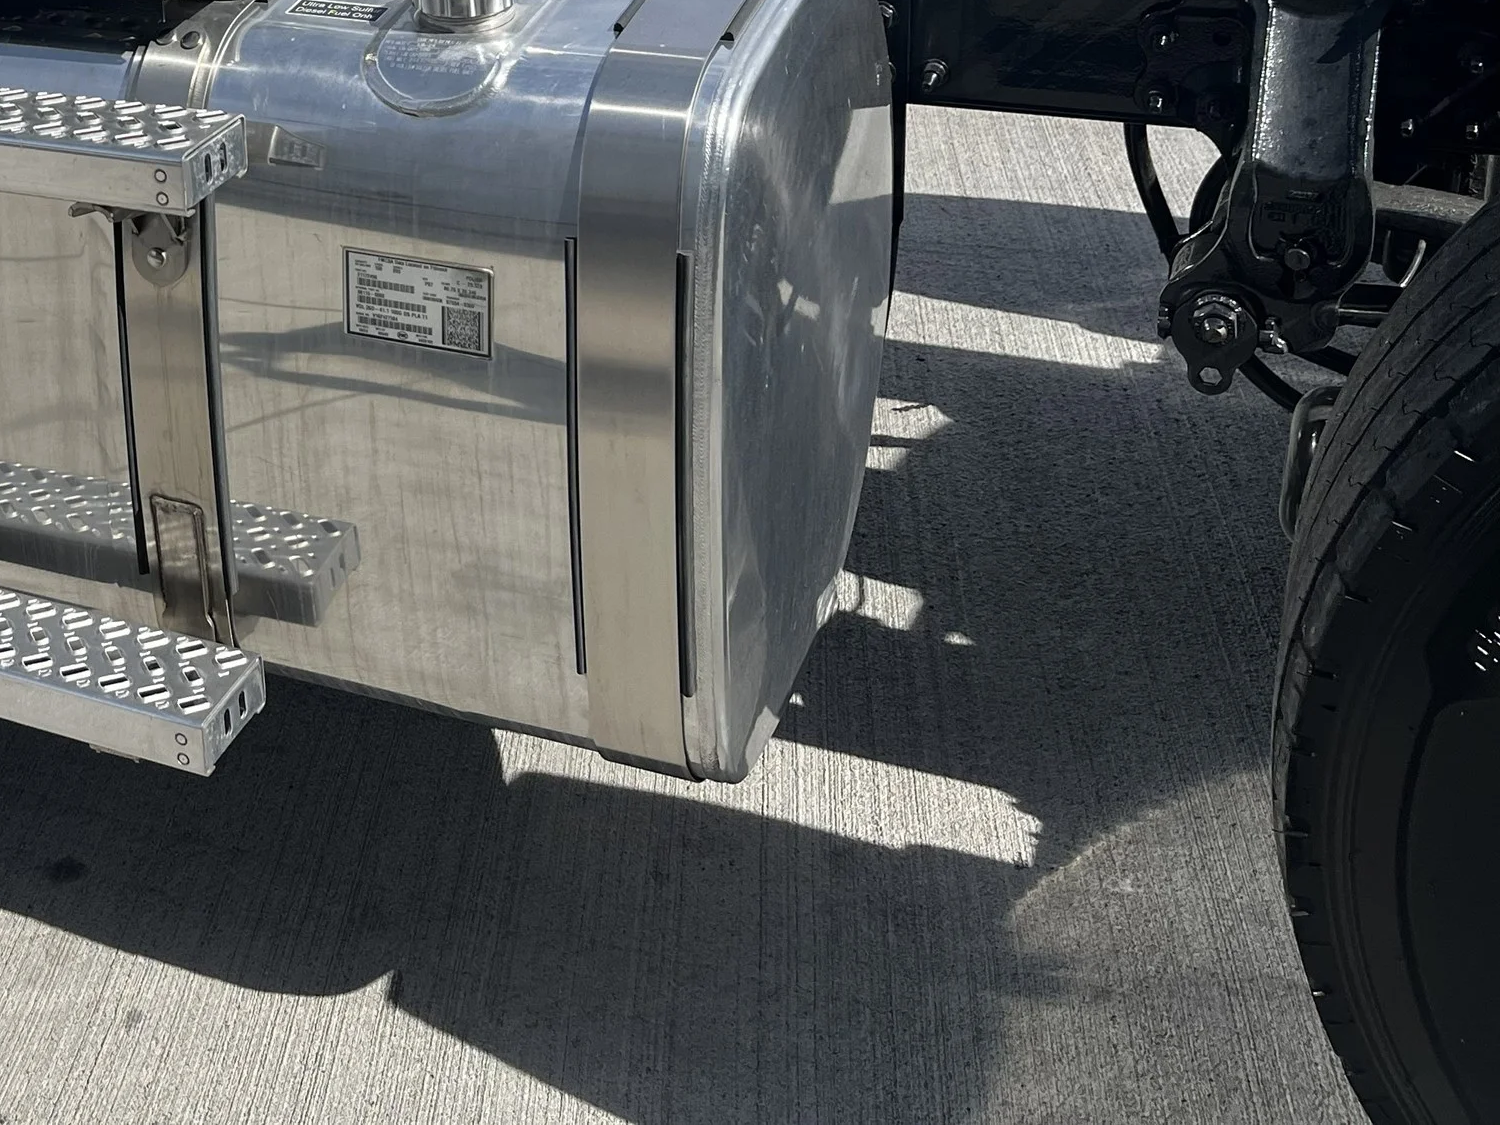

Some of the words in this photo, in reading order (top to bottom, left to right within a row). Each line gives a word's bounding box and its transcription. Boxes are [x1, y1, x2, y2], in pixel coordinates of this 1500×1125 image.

[301, 1, 326, 9] Ultra
[327, 3, 350, 11] Low
[295, 6, 327, 15] Diesel
[327, 9, 351, 17] Fuel
